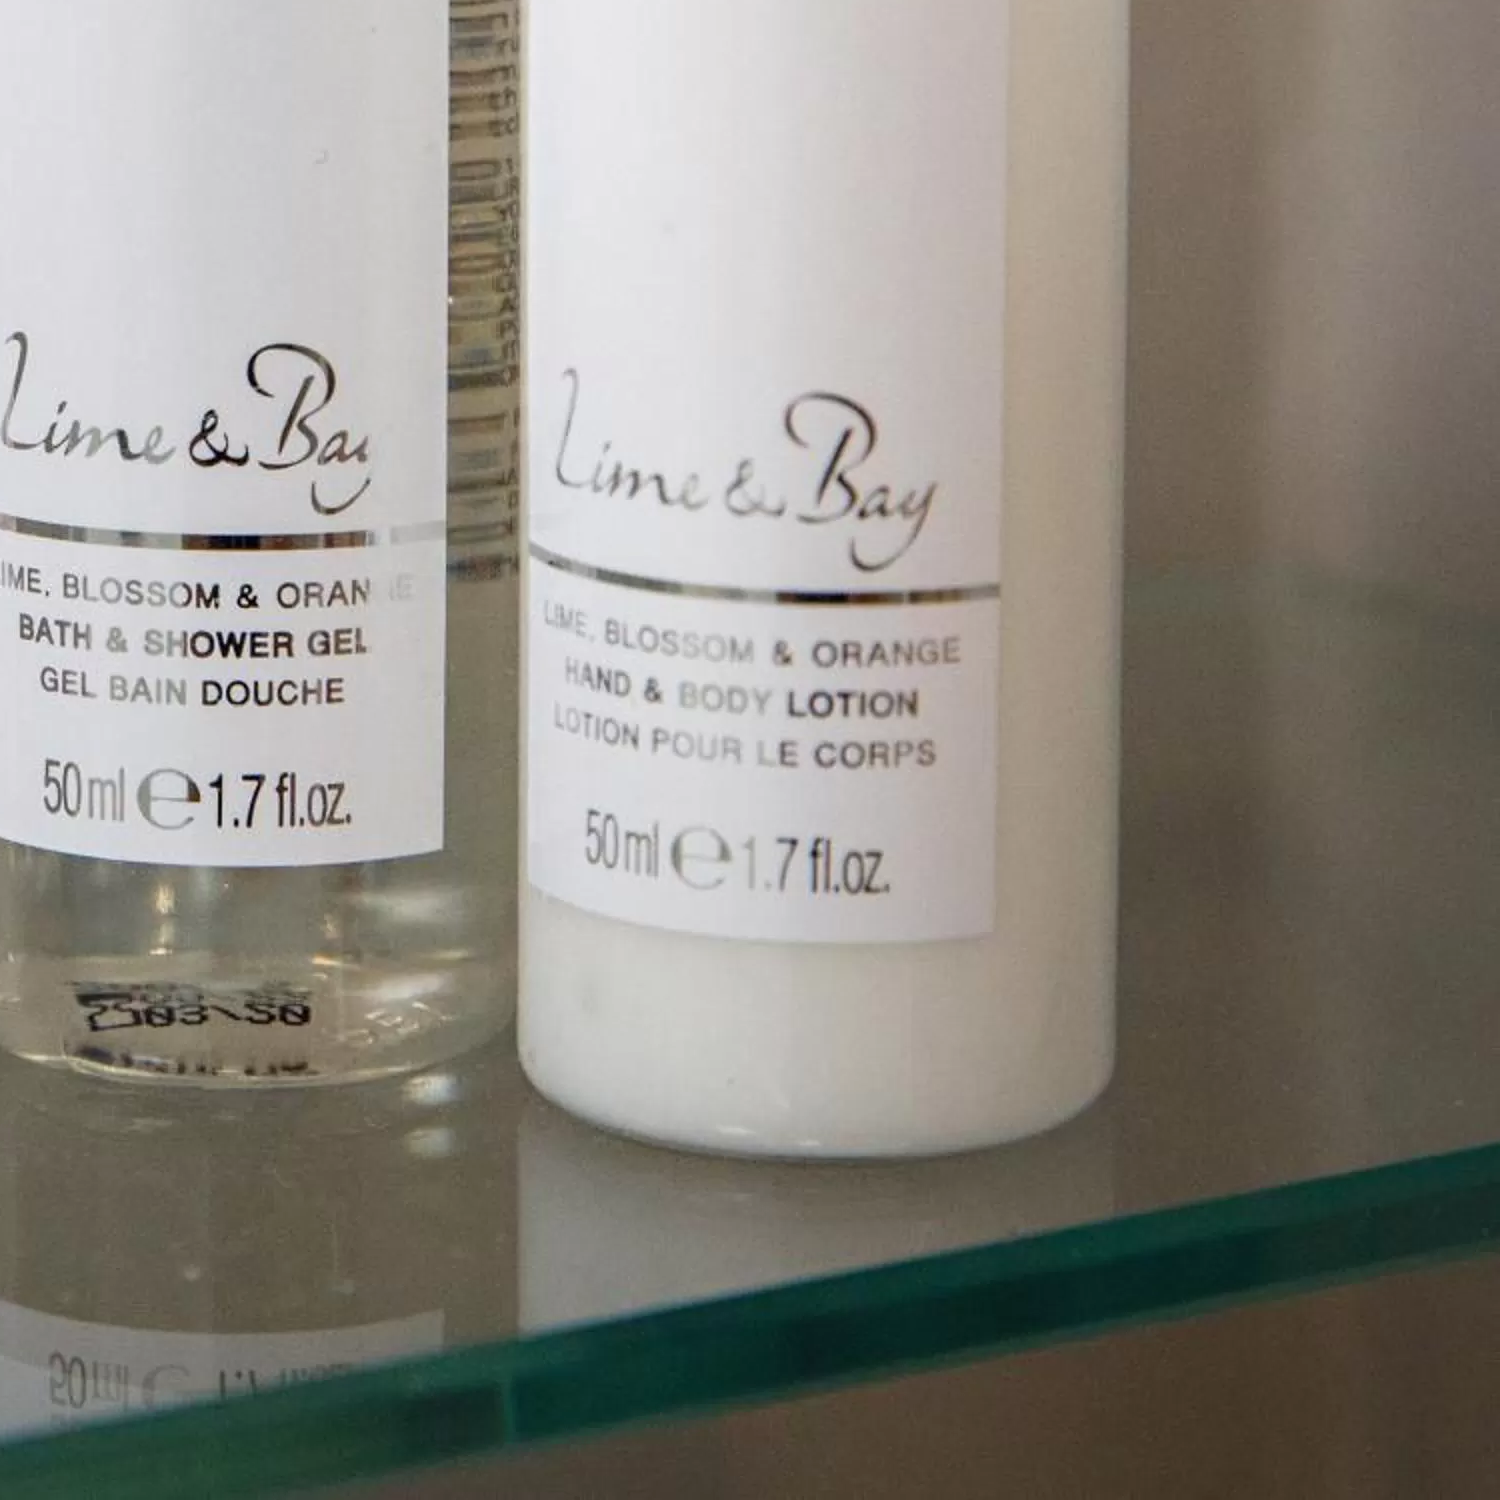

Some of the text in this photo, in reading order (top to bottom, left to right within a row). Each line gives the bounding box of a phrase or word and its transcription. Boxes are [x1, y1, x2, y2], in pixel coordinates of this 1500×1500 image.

[0, 331, 176, 465] Lime
[189, 409, 249, 467] &
[555, 367, 937, 572] Lime & Bay
[63, 574, 219, 609] BLOSSOM
[237, 586, 259, 609] &
[19, 613, 367, 659] BATH & SHOWER GEL
[604, 618, 755, 663] BLOSSOM
[773, 640, 792, 665] &
[811, 636, 961, 668] ORANGE
[40, 666, 345, 707] GEL BAIN DOUCHE
[564, 657, 920, 719] HAND & BODY LOTION
[553, 704, 937, 769] LOTION POUR LE CORPS
